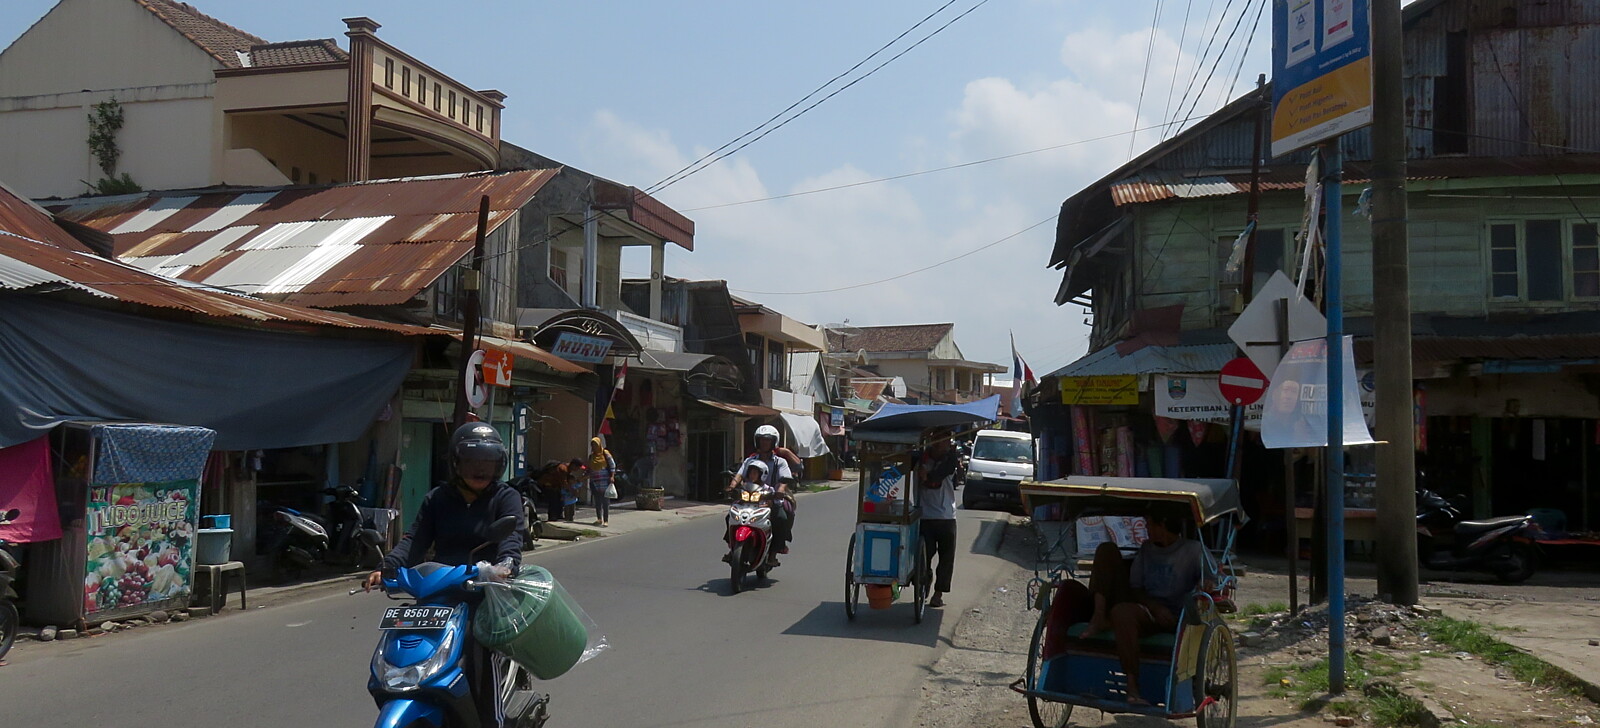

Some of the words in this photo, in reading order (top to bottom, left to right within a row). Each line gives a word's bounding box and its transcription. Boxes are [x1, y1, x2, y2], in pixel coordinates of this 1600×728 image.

[556, 340, 608, 357] MURNI
[100, 504, 141, 528] LIDO
[141, 501, 186, 525] JUICE
[385, 609, 400, 618] BE
[403, 608, 429, 618] 8560
[433, 608, 449, 618] MP
